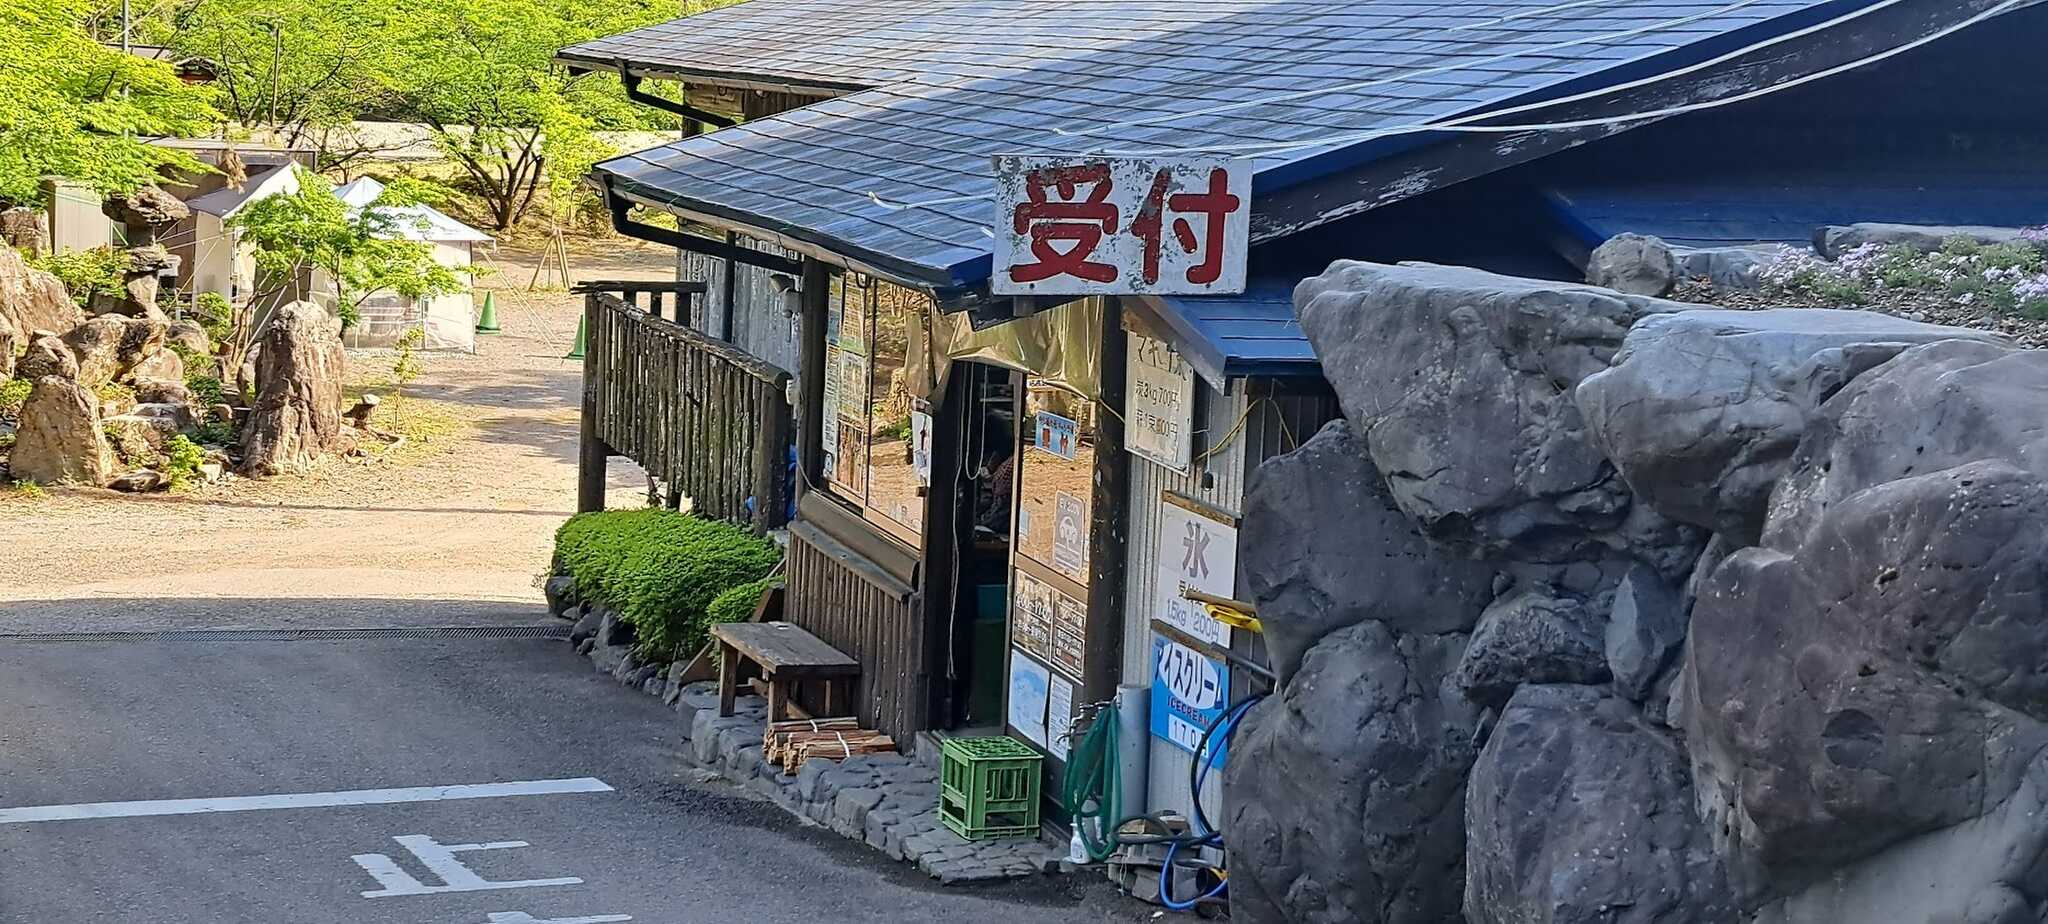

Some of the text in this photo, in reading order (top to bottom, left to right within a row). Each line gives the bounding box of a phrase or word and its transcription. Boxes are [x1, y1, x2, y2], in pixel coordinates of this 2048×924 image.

[1010, 164, 1240, 285] 受付
[1182, 520, 1210, 580] 氷
[1194, 610, 1220, 642] 200円
[1155, 638, 1224, 711] アイスクリーム
[351, 834, 585, 898] 止
